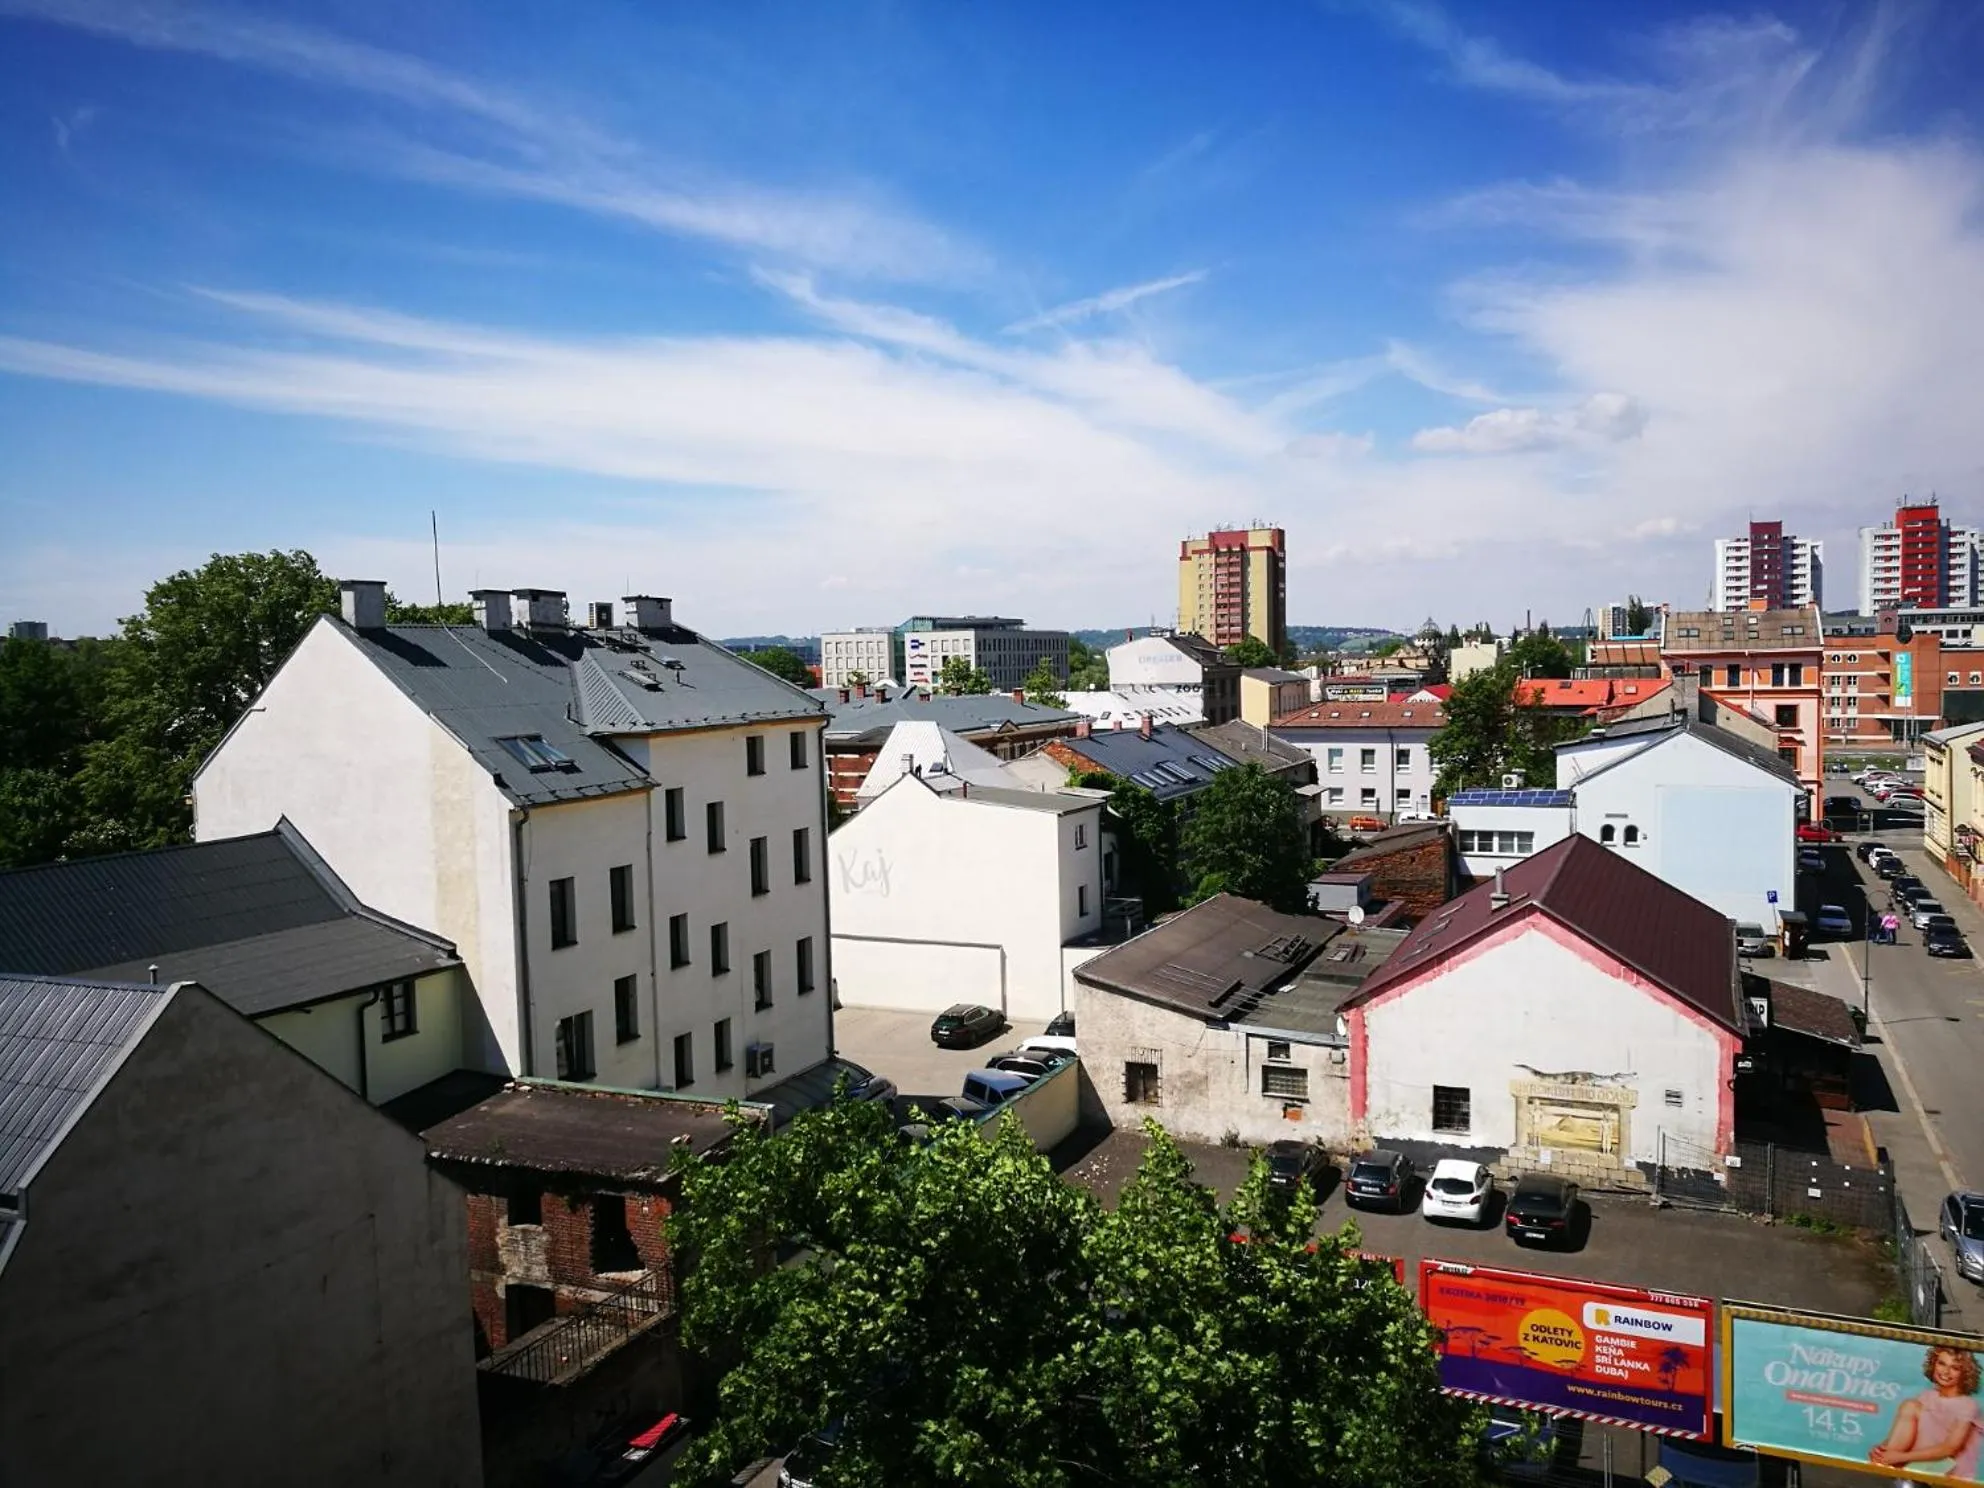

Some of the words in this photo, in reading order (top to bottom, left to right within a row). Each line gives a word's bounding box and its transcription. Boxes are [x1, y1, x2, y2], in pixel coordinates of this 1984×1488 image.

[1530, 1323, 1573, 1337] ODLETY
[1614, 1315, 1673, 1332] RAINBOW
[1522, 1333, 1530, 1342] Z
[1532, 1334, 1582, 1350] KATOVIC
[1595, 1334, 1637, 1349] GAMBIE
[1595, 1364, 1629, 1380] DUBAJ
[1612, 1355, 1651, 1373] LANKA
[1764, 1360, 1901, 1401] OnaDnes
[1567, 1385, 1684, 1411] www.rainbowtours.cz
